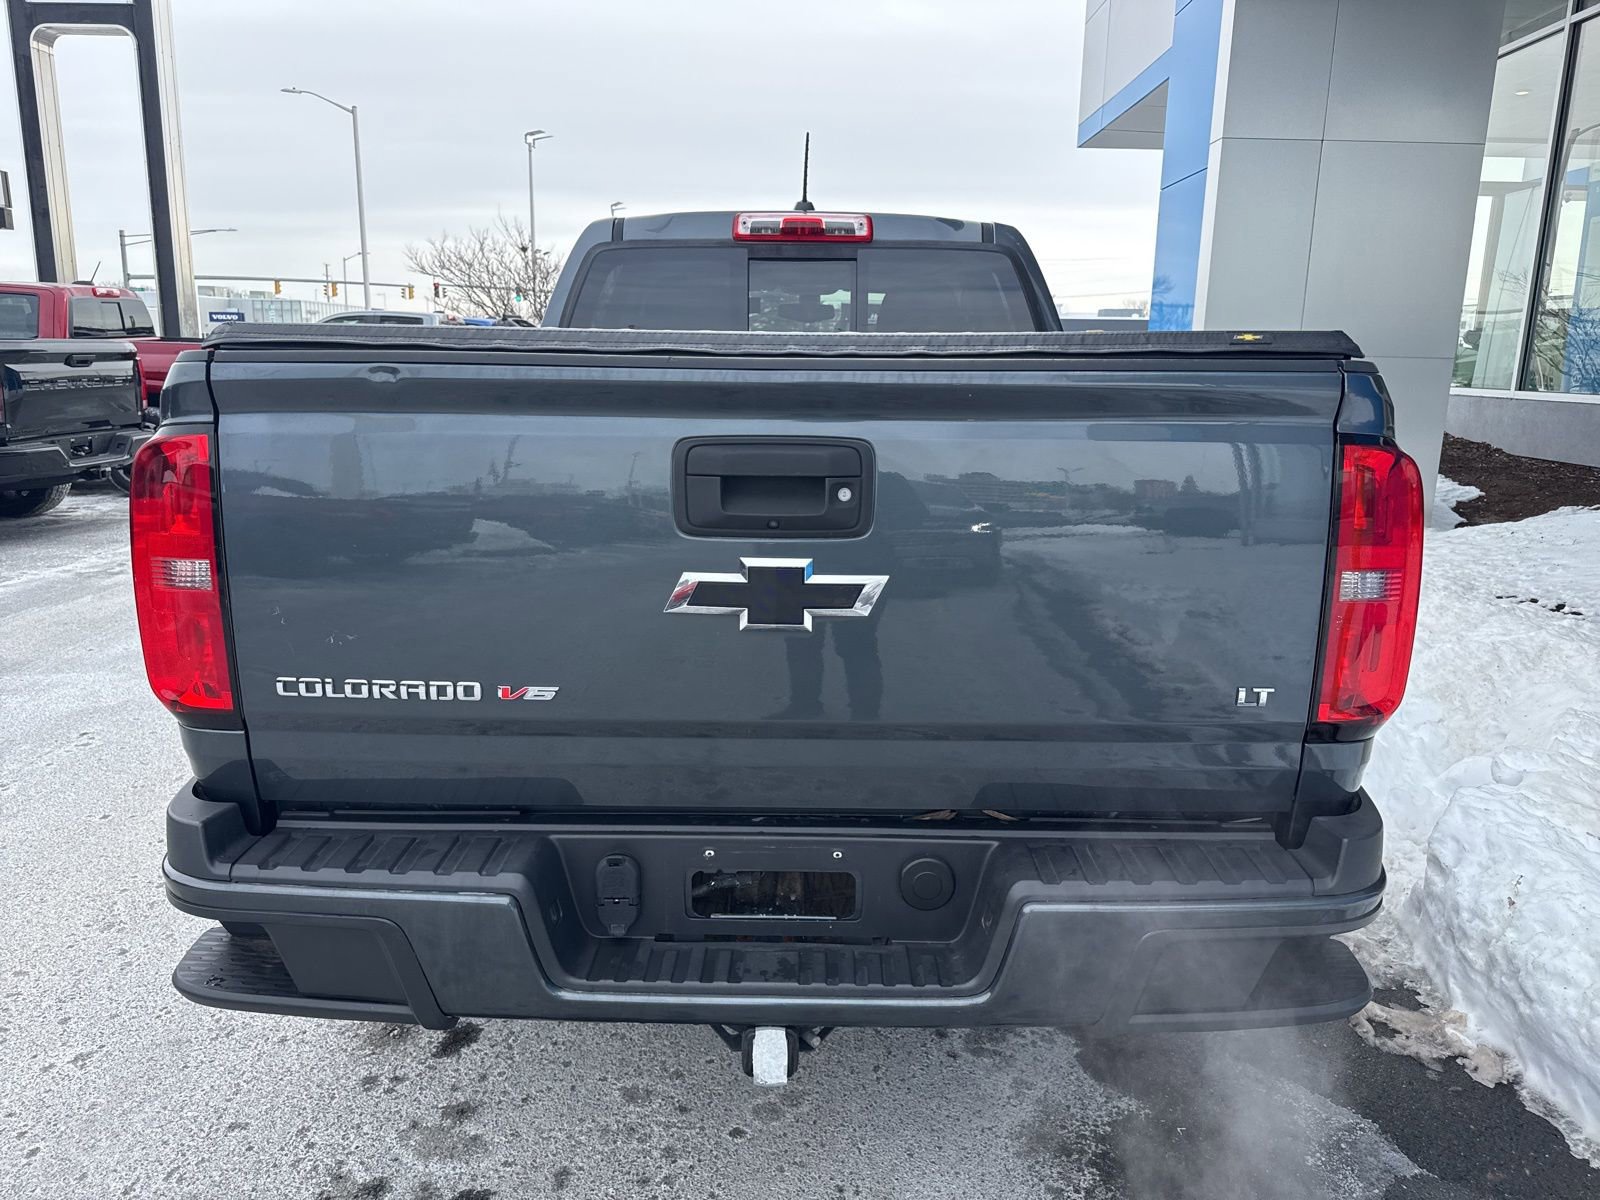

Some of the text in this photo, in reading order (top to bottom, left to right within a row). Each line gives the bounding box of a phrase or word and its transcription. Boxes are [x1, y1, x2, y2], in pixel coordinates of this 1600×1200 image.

[275, 676, 560, 702] COLORADO V6
[1236, 687, 1275, 707] LT
